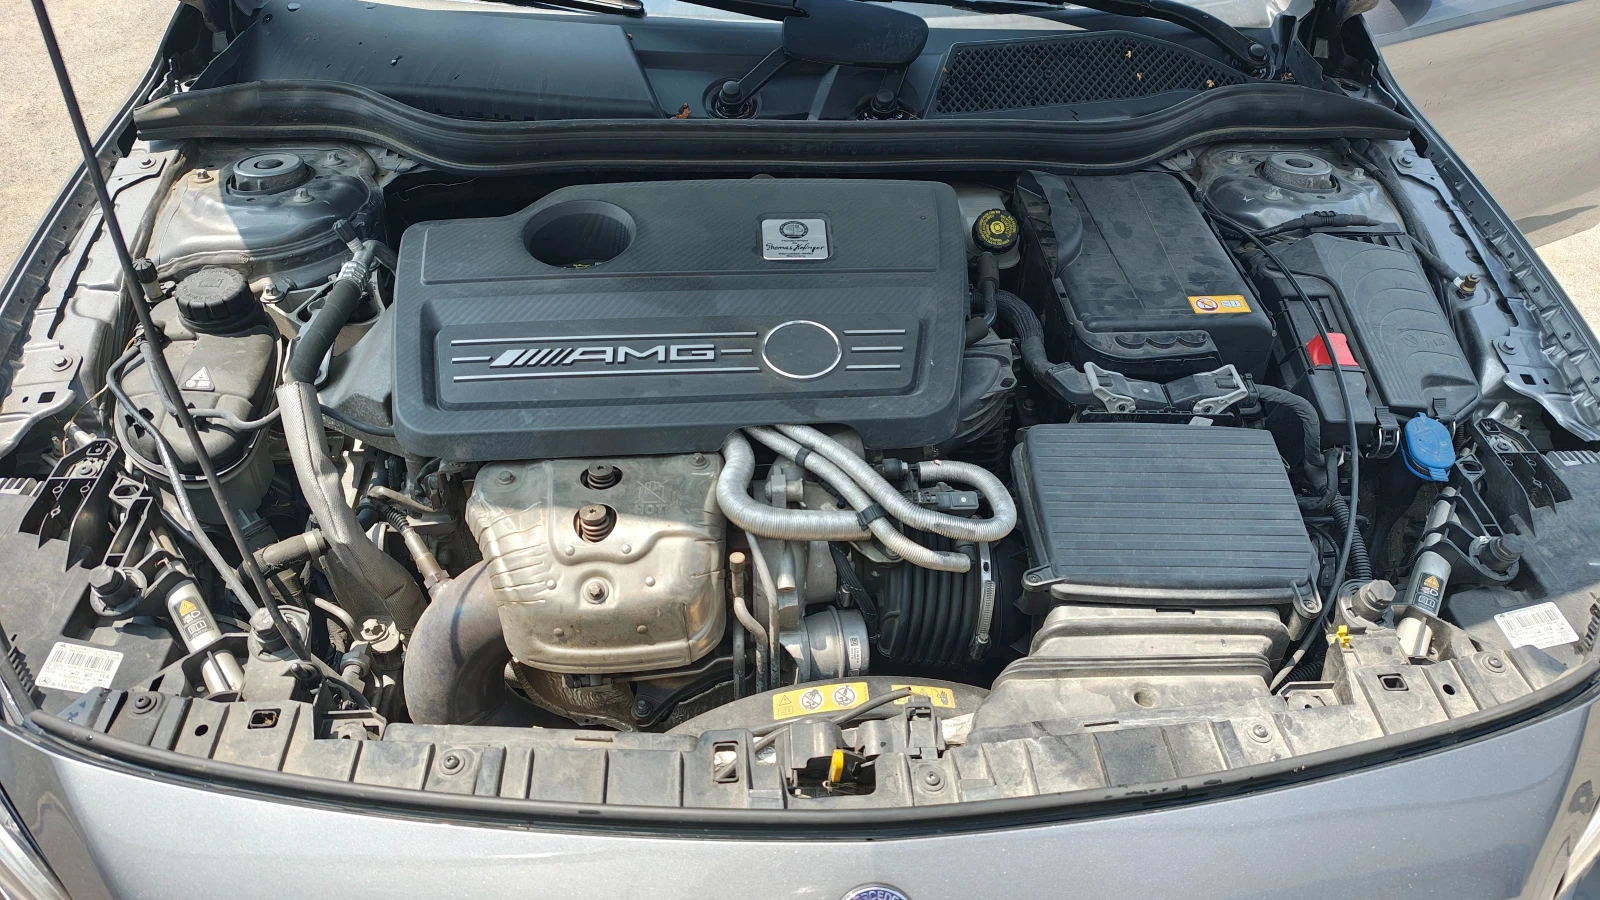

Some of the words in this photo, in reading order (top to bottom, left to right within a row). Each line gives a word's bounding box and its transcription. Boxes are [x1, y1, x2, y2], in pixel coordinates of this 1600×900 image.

[765, 242, 793, 251] Thomas
[562, 344, 715, 366] AMG
[634, 504, 665, 515] HOT
